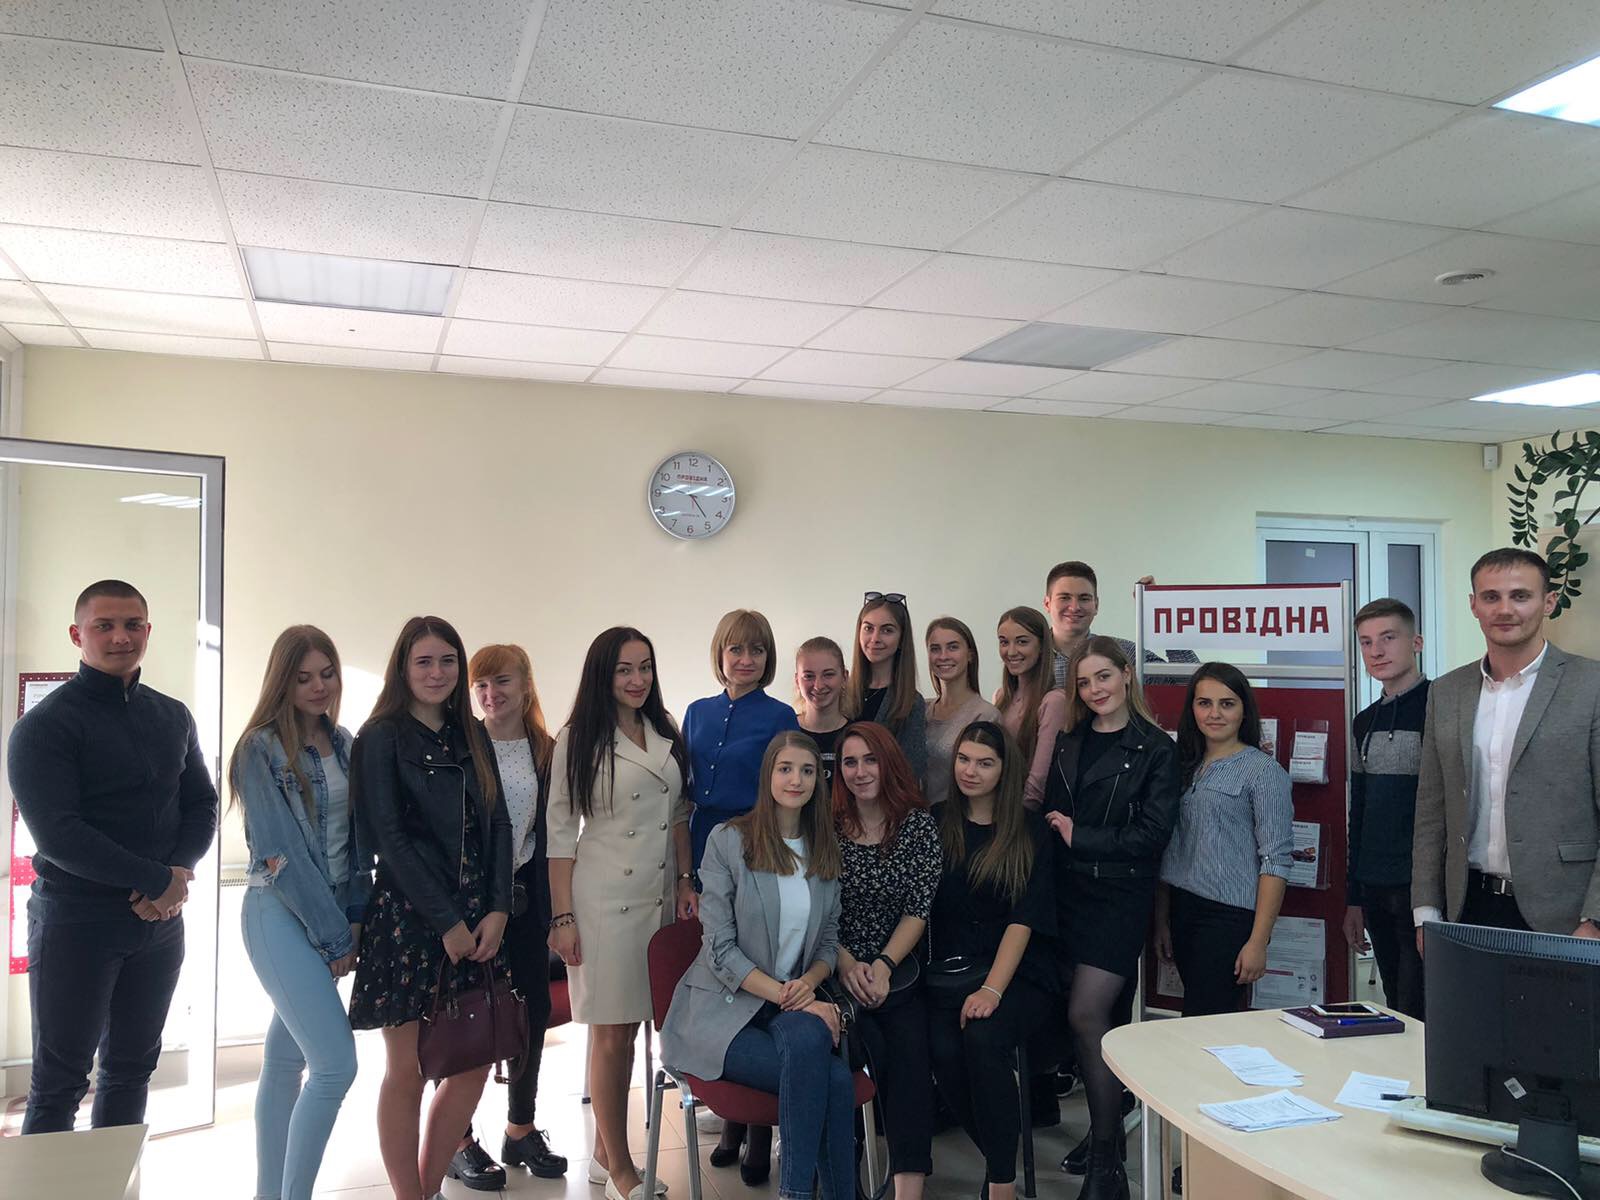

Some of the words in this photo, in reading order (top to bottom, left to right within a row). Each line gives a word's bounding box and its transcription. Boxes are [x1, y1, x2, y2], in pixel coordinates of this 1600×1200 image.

[673, 461, 680, 470] 11
[689, 458, 698, 467] 12
[707, 464, 711, 472] 1
[660, 472, 671, 481] 10
[717, 478, 724, 486] 2
[654, 488, 661, 497] 9
[721, 495, 728, 503] 3
[715, 511, 722, 519] 4
[672, 519, 677, 527] 7
[704, 521, 711, 530] 5
[687, 525, 694, 534] 6
[1154, 606, 1329, 637] ПРОВІДНА
